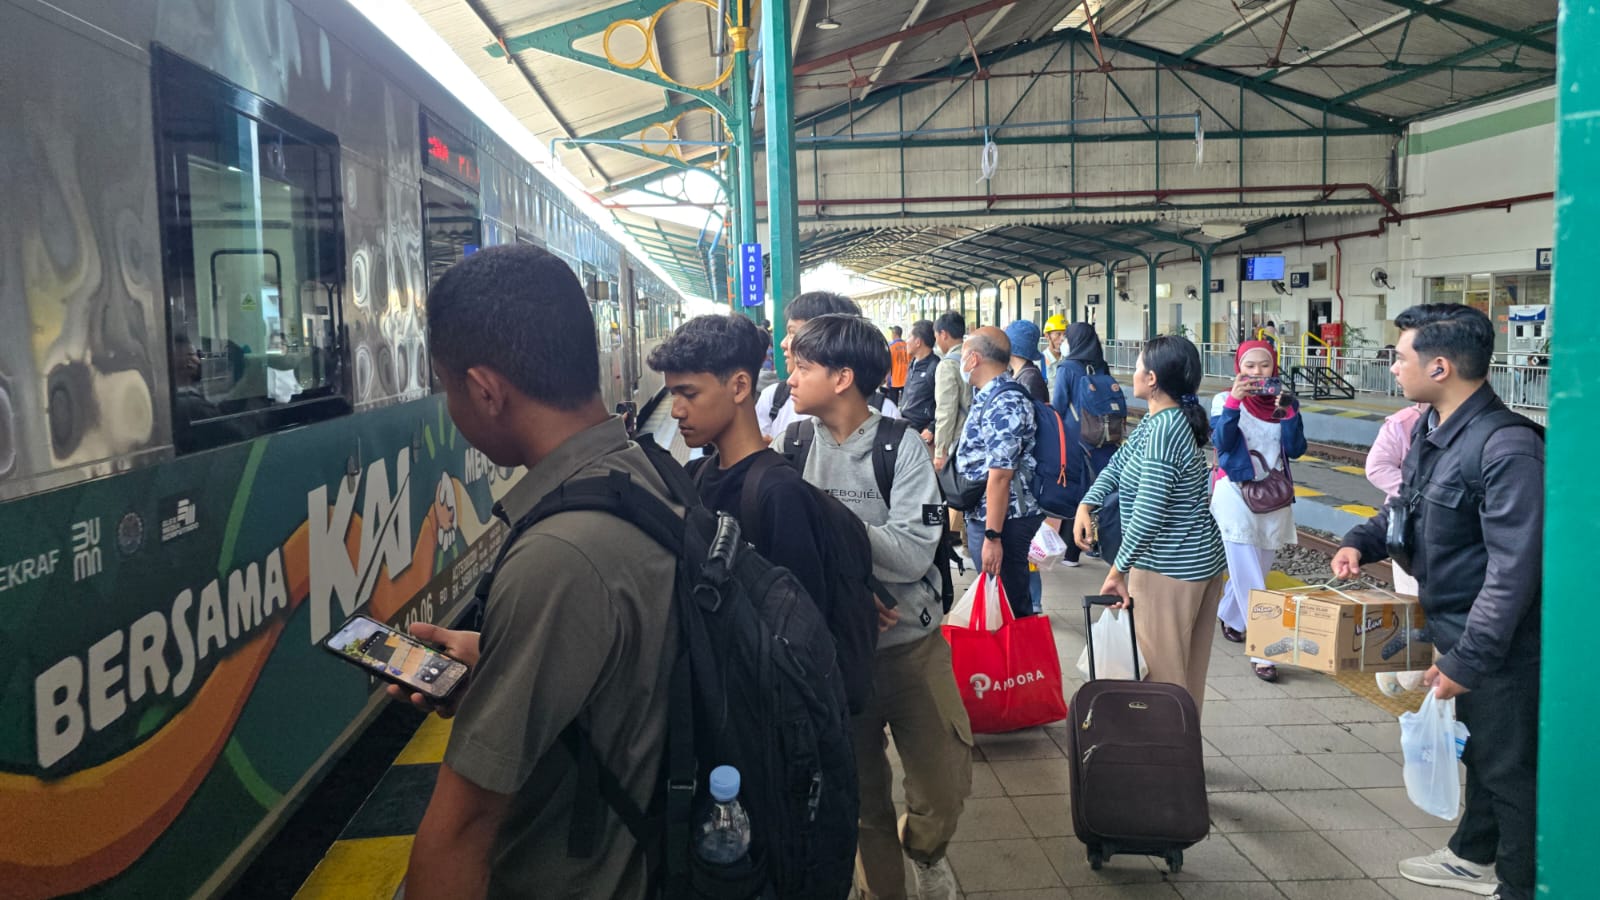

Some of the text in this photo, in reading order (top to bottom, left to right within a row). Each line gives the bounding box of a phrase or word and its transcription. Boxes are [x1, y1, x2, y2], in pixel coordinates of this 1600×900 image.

[747, 246, 757, 301] MADIUN
[35, 446, 411, 768] BERSAMA KAI
